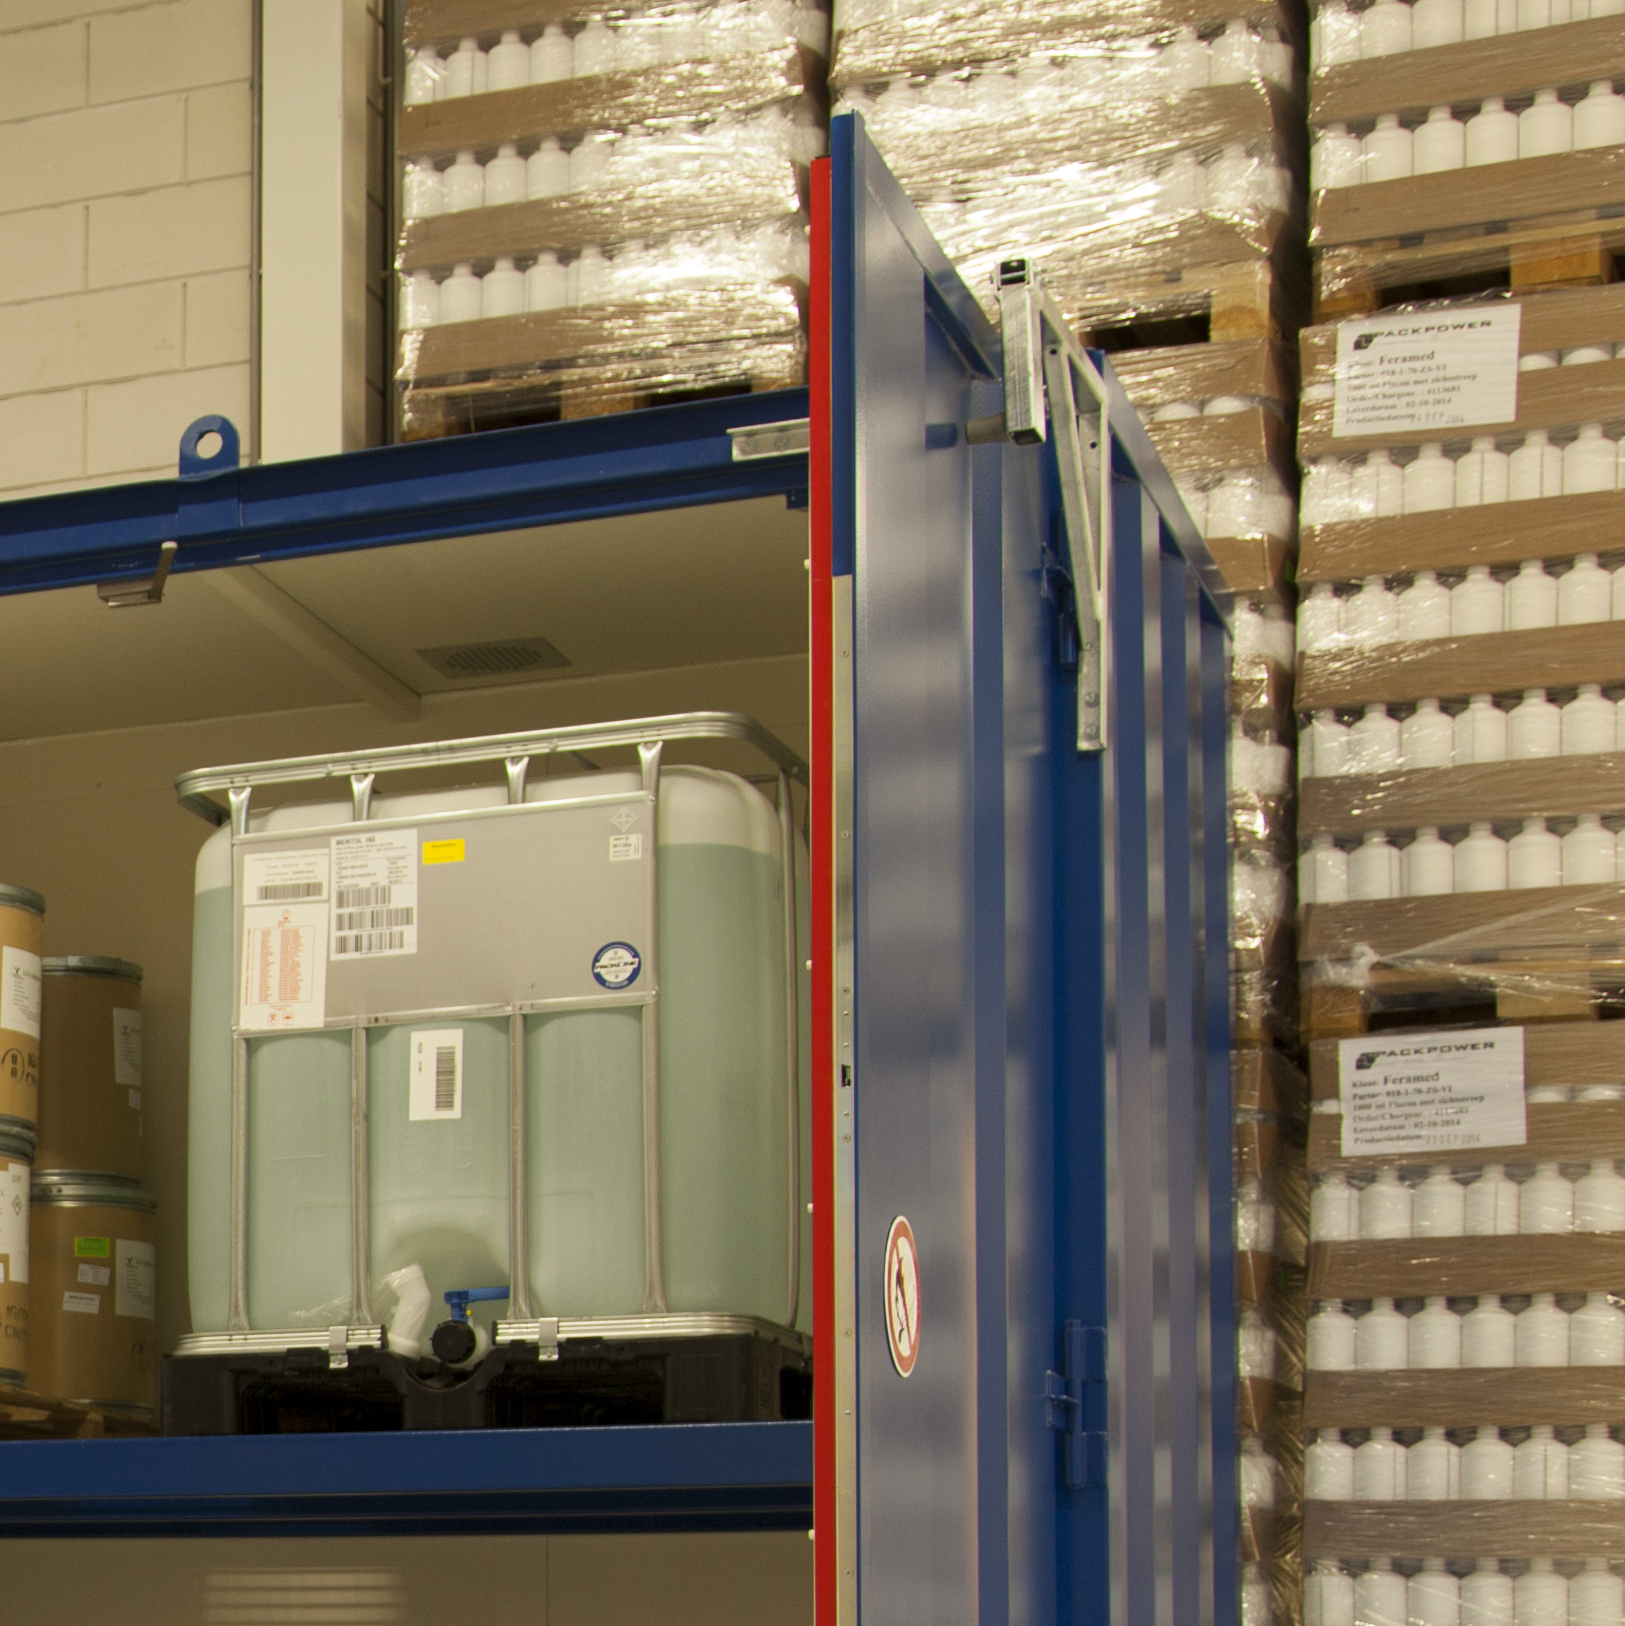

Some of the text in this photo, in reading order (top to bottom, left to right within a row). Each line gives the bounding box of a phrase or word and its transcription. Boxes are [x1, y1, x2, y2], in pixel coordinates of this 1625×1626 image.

[1374, 320, 1492, 338] PACKPOWER
[1379, 351, 1436, 366] Feramed
[1375, 1041, 1496, 1058] PACKPOWER
[1383, 1072, 1440, 1086] Feramed
